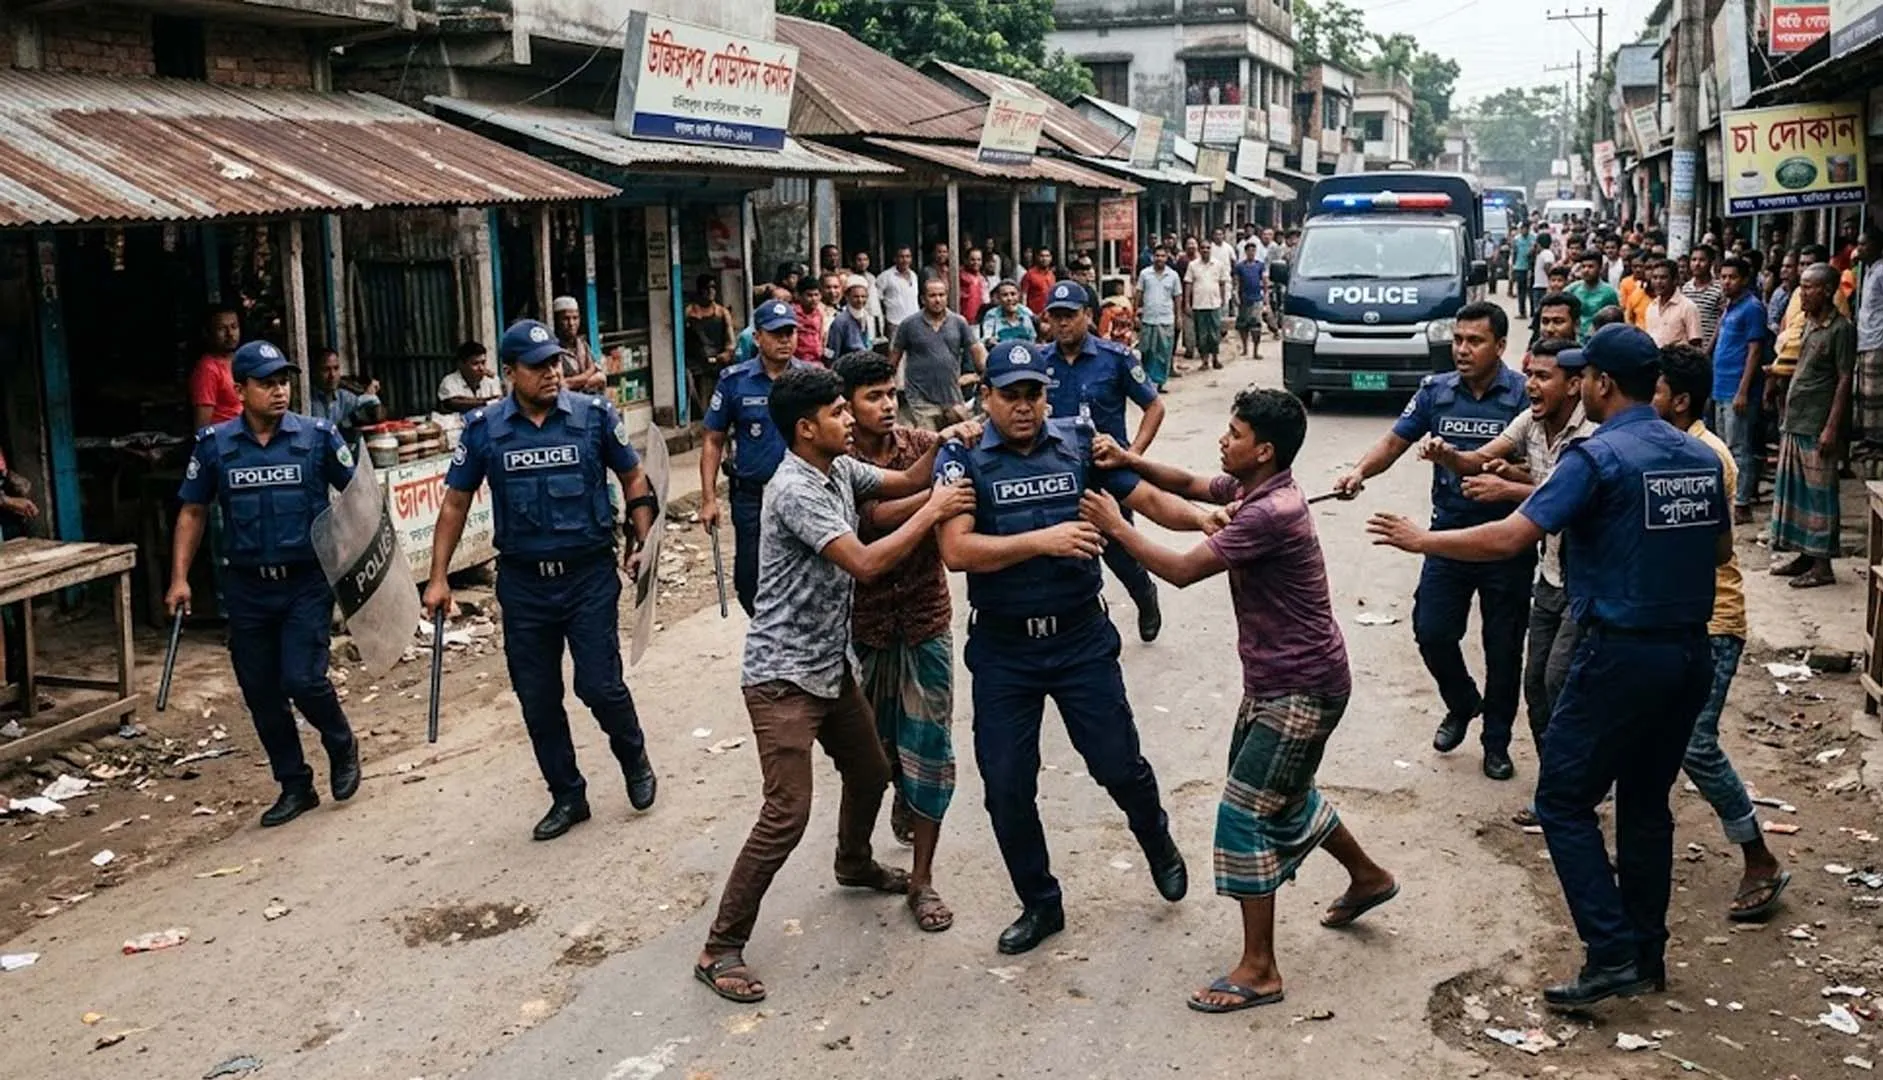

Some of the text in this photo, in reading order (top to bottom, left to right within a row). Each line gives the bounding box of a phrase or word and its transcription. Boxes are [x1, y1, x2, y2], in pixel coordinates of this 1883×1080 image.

[1730, 112, 1859, 154] চা দোকান
[1327, 286, 1419, 304] POLICE
[1444, 420, 1499, 434] POLICE
[510, 448, 574, 466] POLICE
[234, 467, 295, 483] POLICE
[1000, 476, 1070, 498] POLICE
[1659, 497, 1711, 524] পুলিশ
